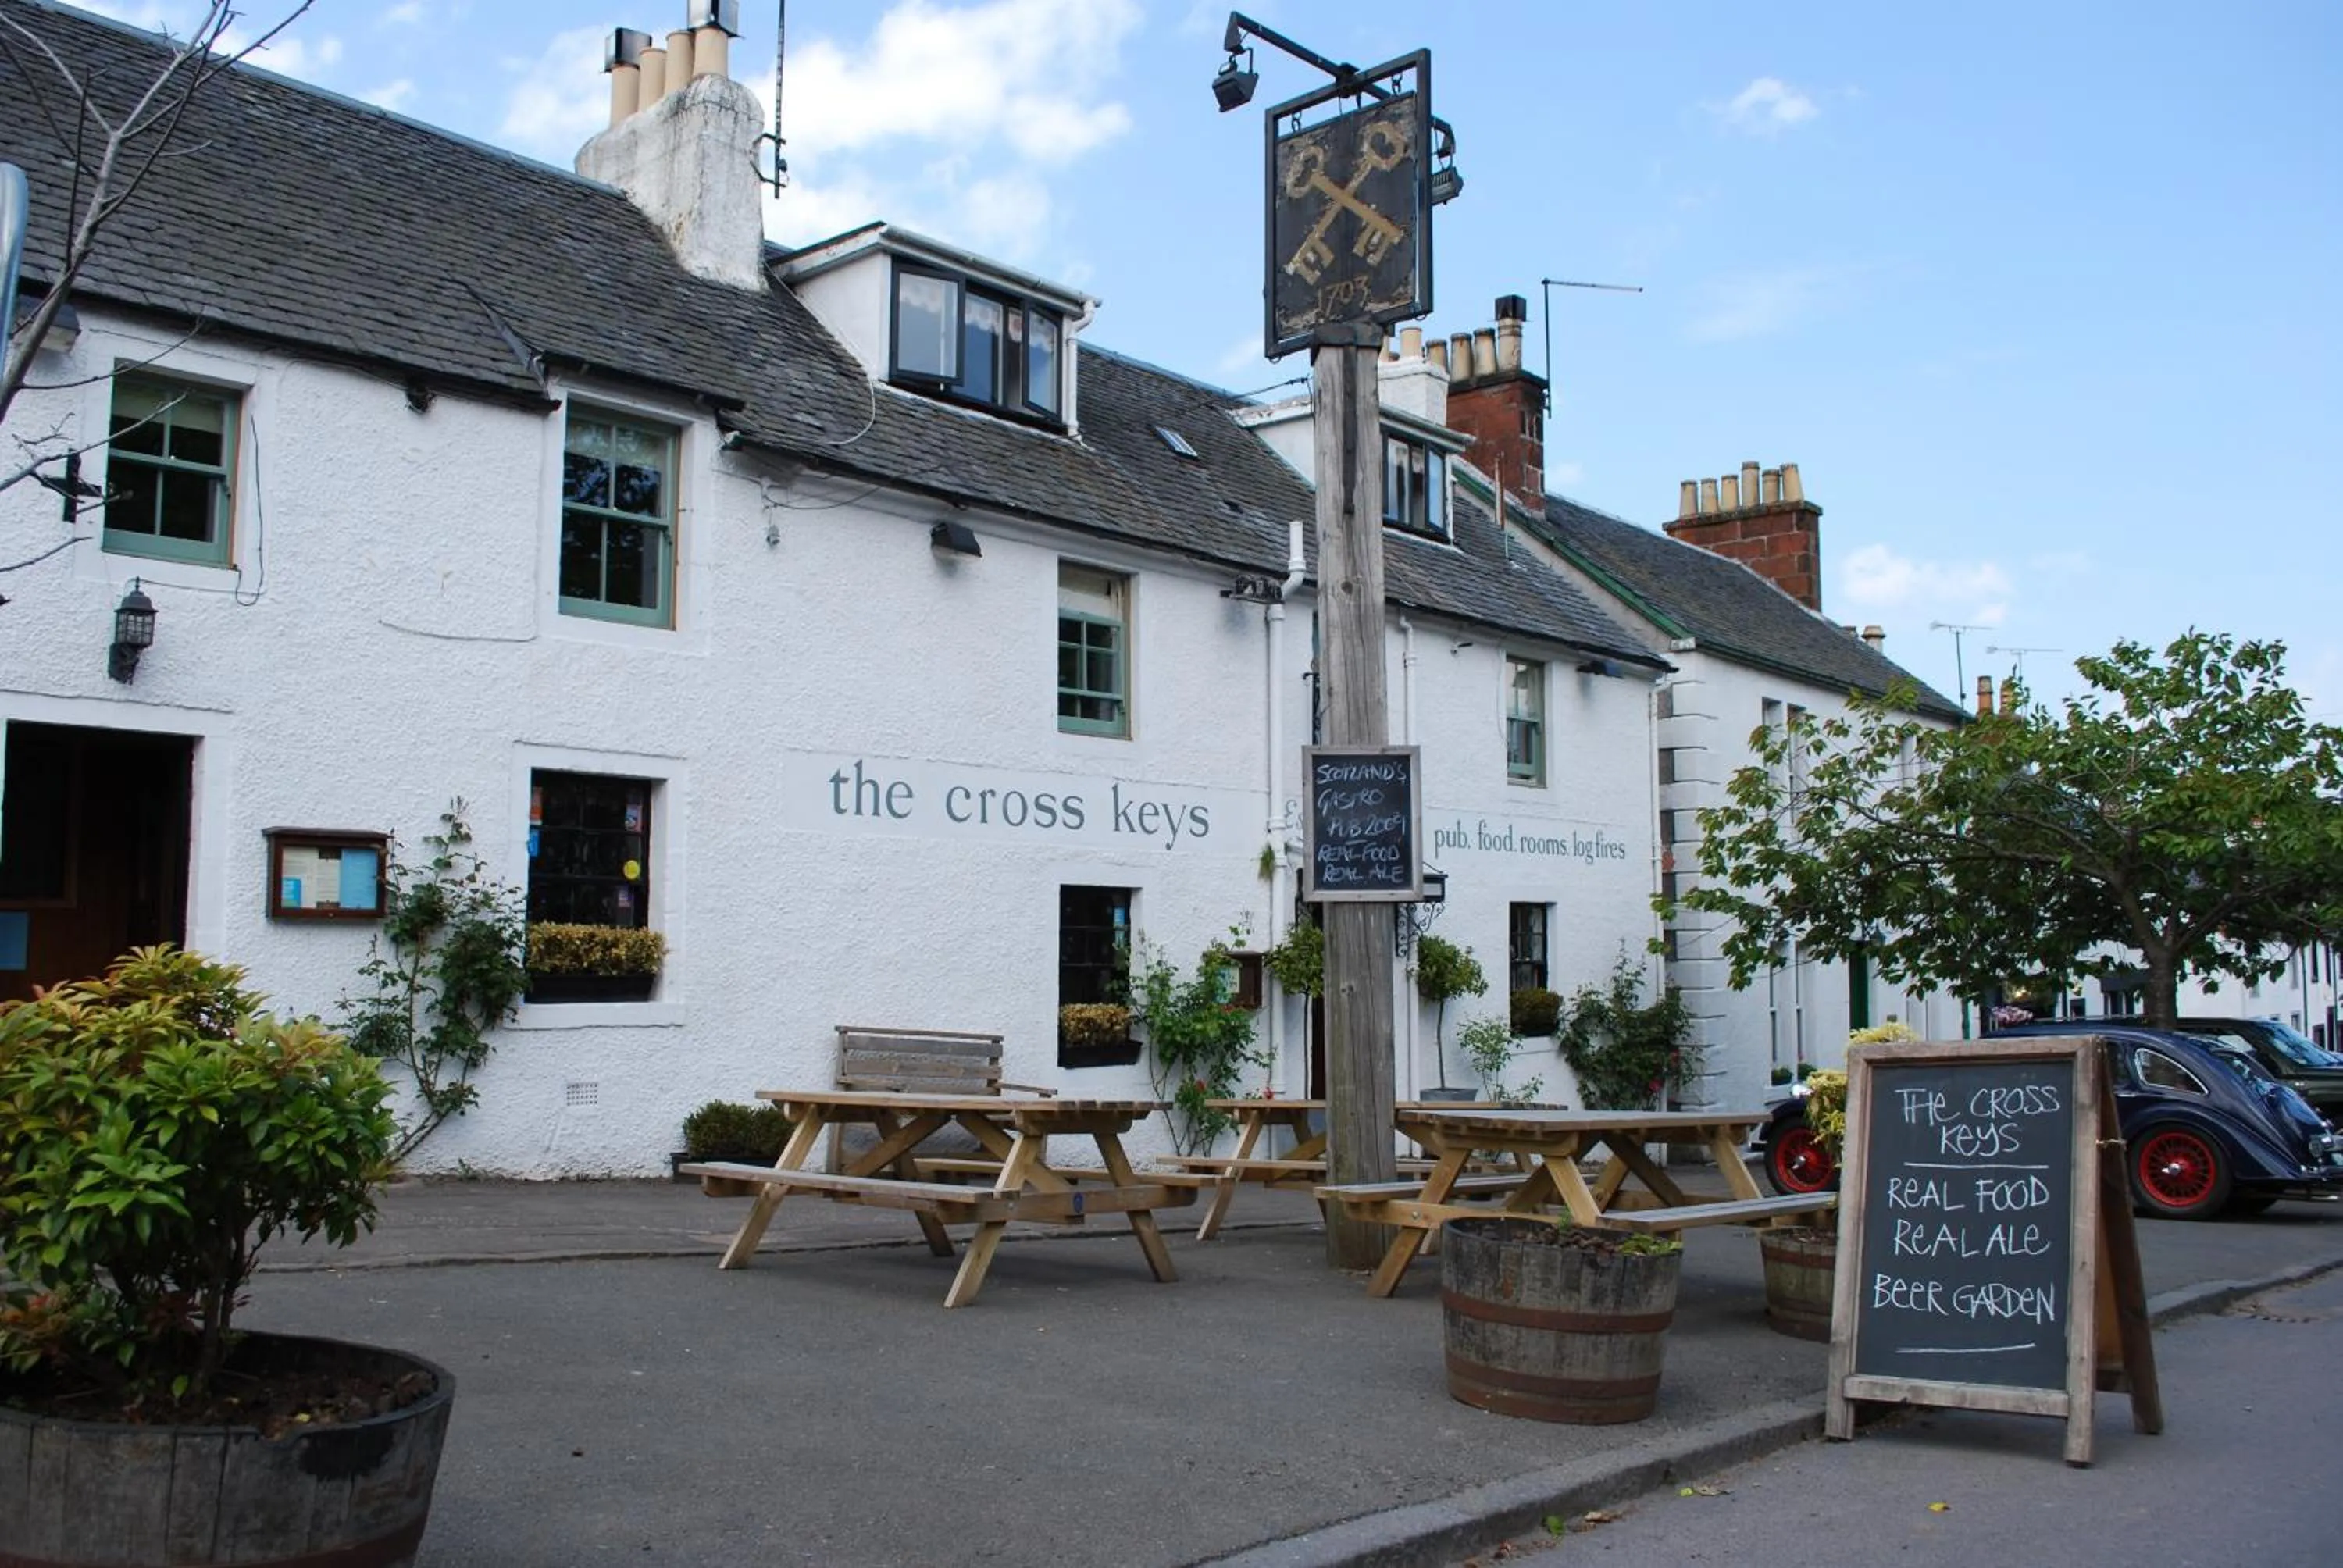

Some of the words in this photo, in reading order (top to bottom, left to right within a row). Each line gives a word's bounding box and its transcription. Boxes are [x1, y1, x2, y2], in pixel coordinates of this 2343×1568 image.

[829, 759, 914, 819] the
[945, 785, 1086, 830] cross
[1111, 782, 1210, 850] keys
[1361, 841, 1400, 861] FOOD
[1434, 818, 1471, 859] pub.
[1573, 829, 1594, 865] log
[1596, 829, 1626, 859] fires
[1970, 1085, 2061, 1119] CROSS
[1975, 1174, 2050, 1213] FOOD
